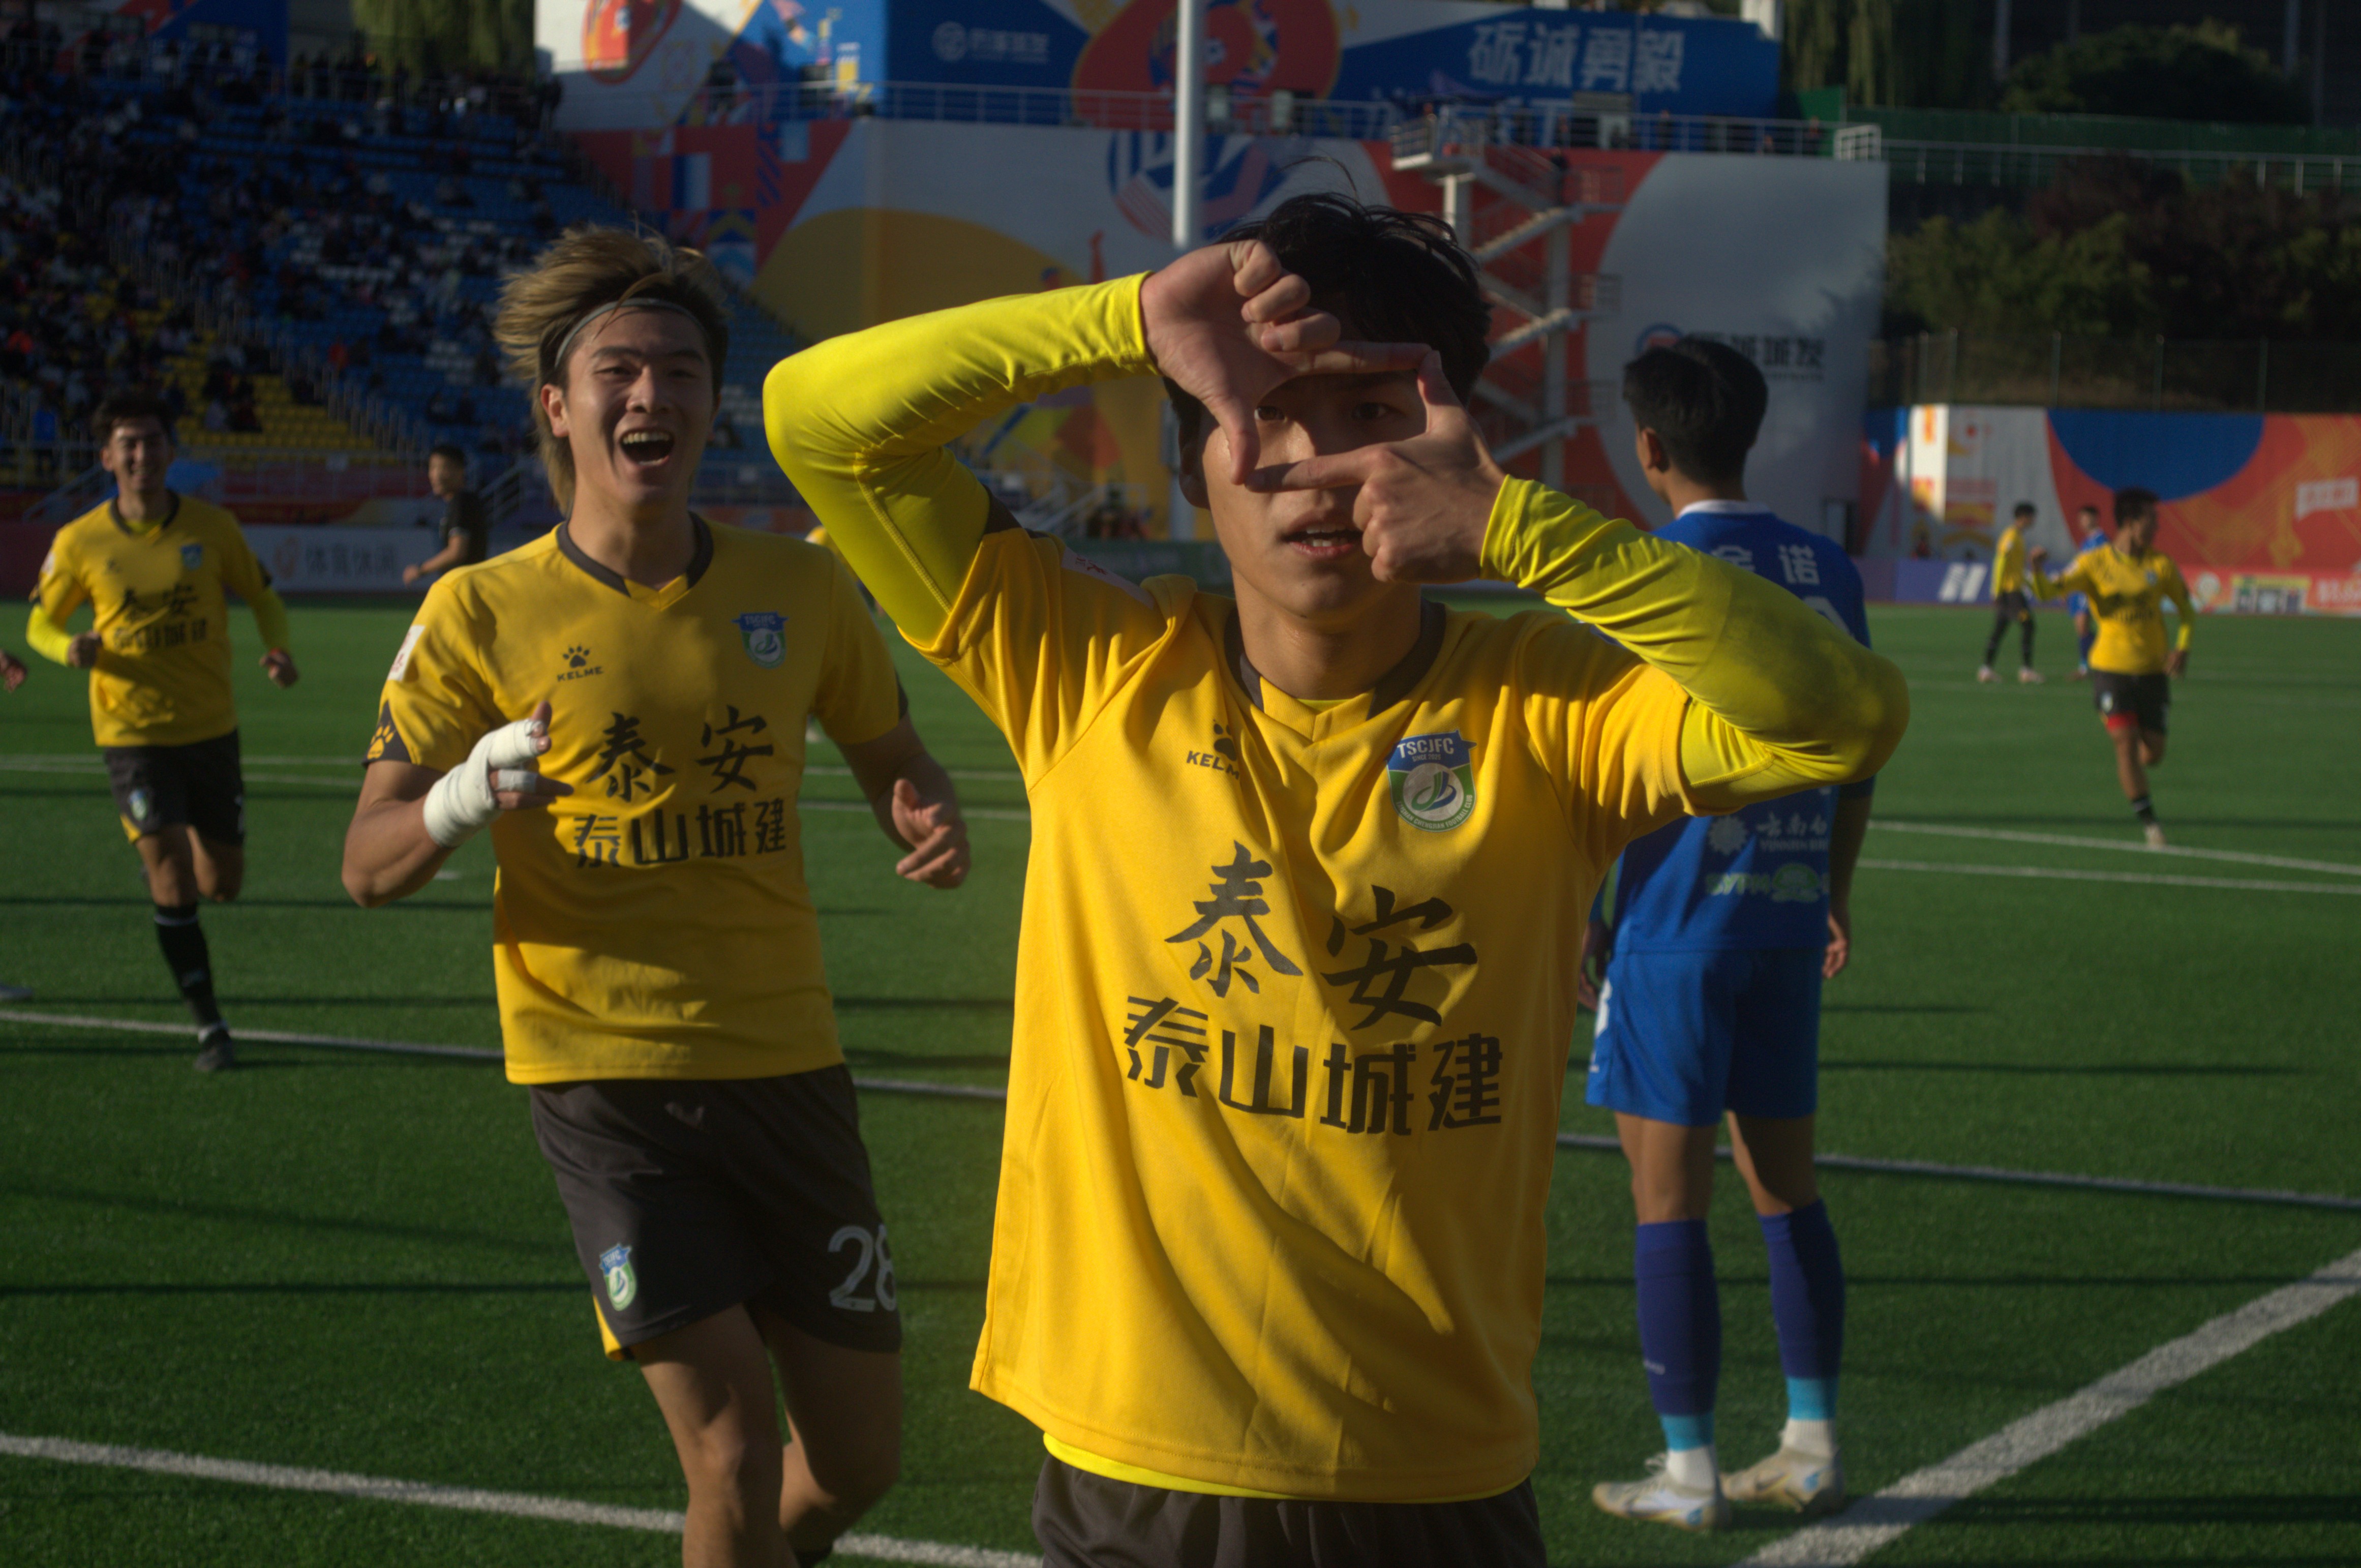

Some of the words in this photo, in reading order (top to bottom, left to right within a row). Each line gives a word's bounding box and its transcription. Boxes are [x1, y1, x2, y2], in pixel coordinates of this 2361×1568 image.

[557, 666, 603, 682] KELME
[586, 705, 774, 802] 泰安
[1186, 750, 1240, 780] KELM
[1397, 737, 1455, 759] TSCJFC
[572, 797, 787, 869] 泰山城建
[1445, 808, 1468, 828] FOOTBALL
[1464, 794, 1473, 808] CLUB
[1164, 839, 1478, 1031] 泰安
[1123, 996, 1503, 1136] 泰山城建
